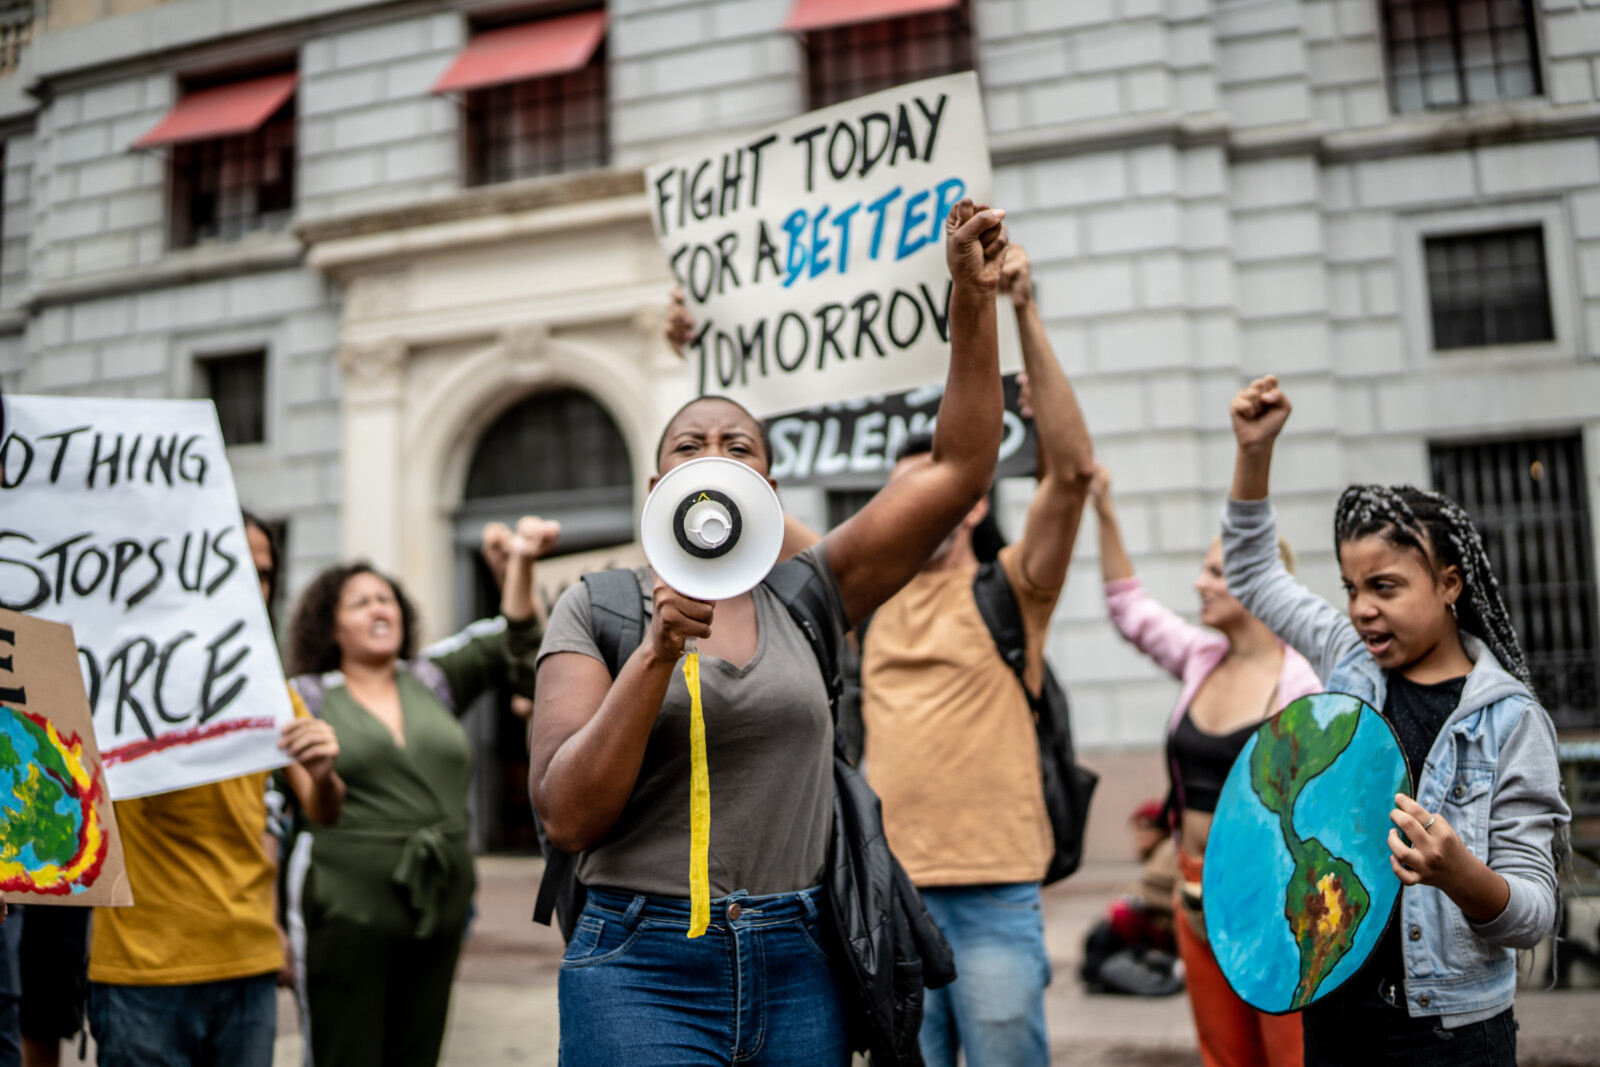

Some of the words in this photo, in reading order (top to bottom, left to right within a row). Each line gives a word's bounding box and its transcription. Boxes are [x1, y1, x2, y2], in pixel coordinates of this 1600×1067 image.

[655, 134, 777, 236] FIGHT
[793, 94, 948, 192] TODAY
[753, 218, 782, 284] A
[0, 425, 209, 489] OTHING
[767, 409, 1026, 479] SILEND
[0, 529, 168, 613] STOPS
[178, 526, 239, 597] US
